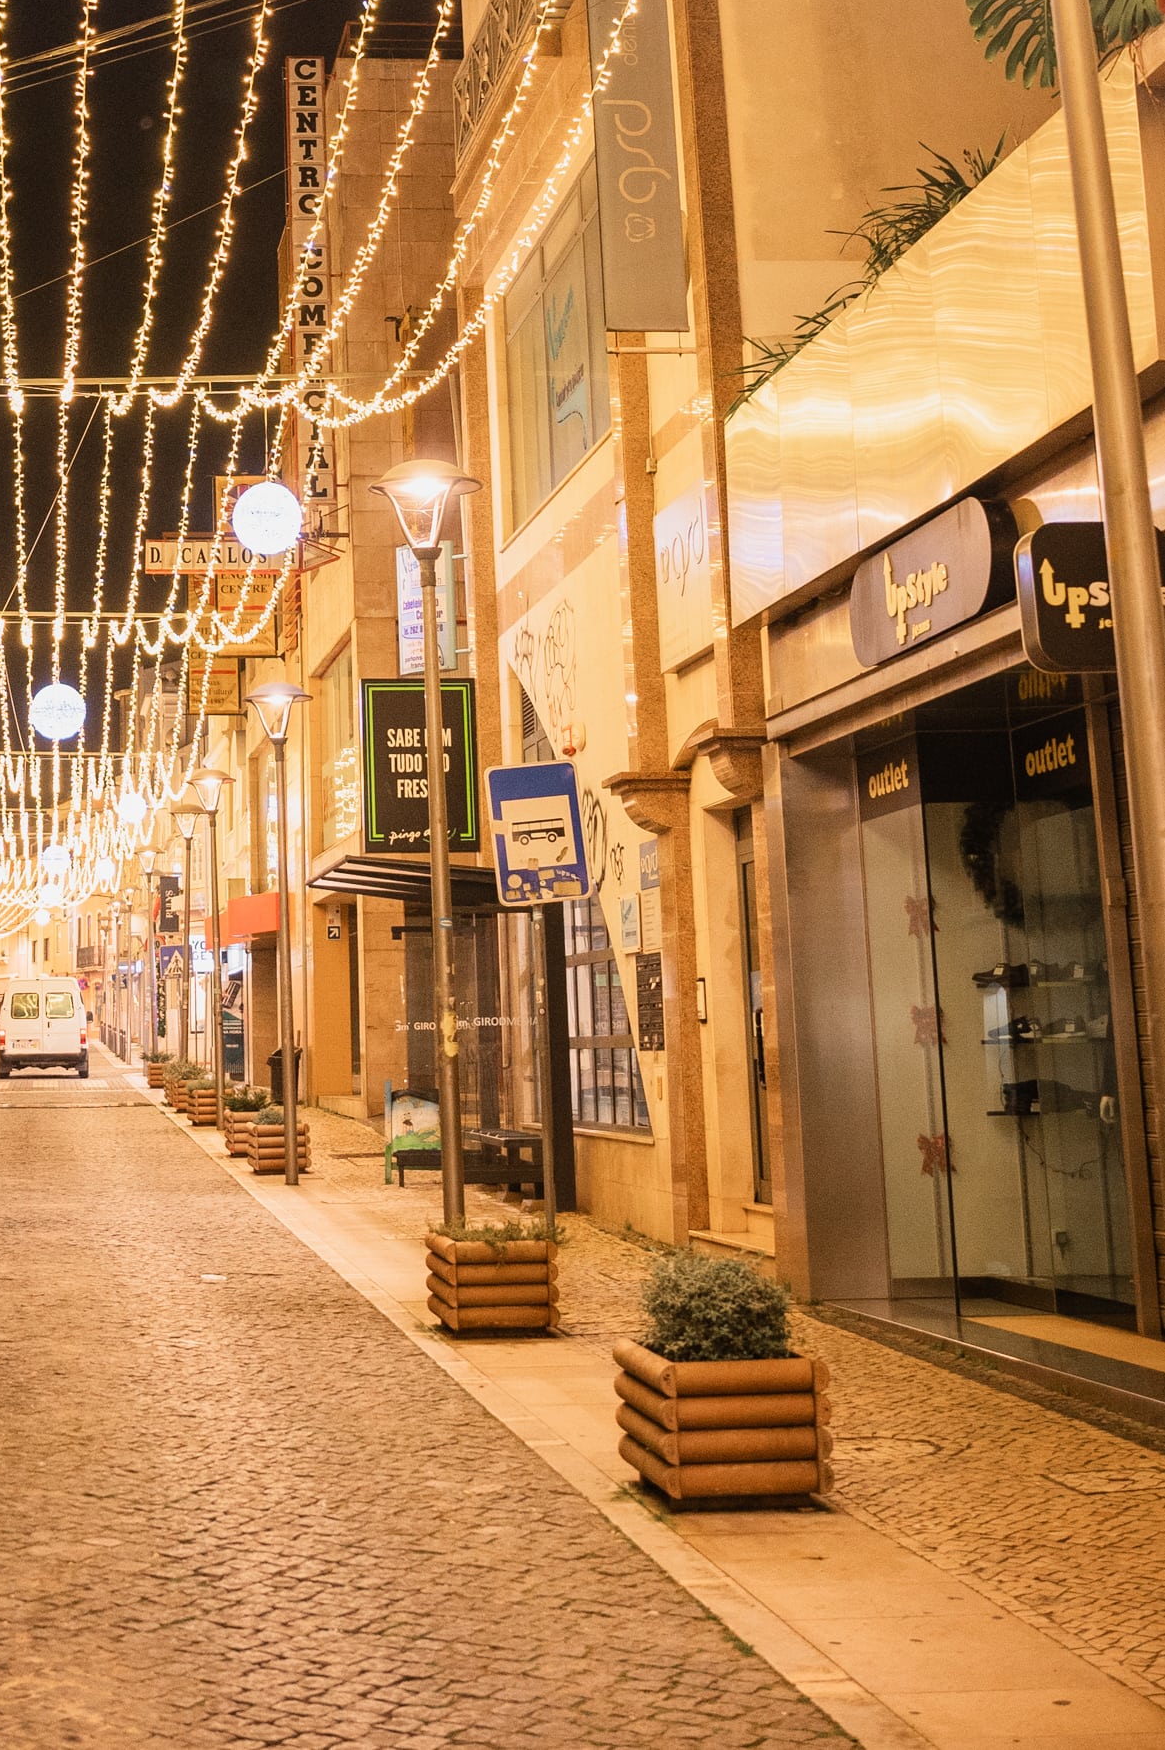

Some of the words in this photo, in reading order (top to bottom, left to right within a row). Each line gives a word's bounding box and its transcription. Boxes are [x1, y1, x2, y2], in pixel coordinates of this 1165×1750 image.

[294, 59, 320, 215] CENTRO
[150, 546, 162, 564] D.
[181, 546, 268, 564] CARLOS
[387, 728, 421, 748] SABE
[388, 753, 422, 773] TUDO
[1024, 733, 1076, 777] outlet
[868, 757, 909, 799] outlet
[396, 779, 429, 799] FRES
[388, 829, 421, 846] pingo
